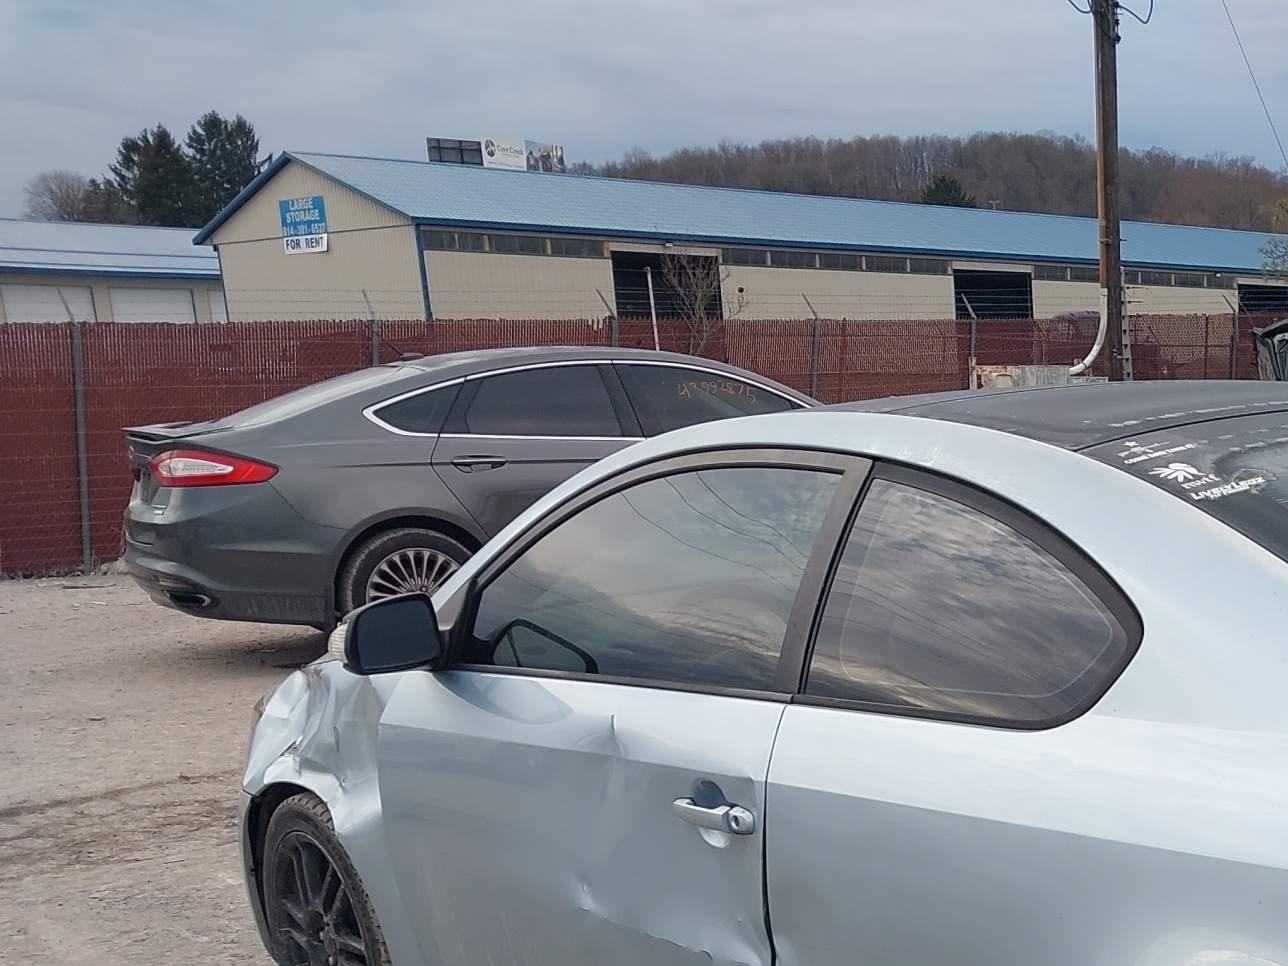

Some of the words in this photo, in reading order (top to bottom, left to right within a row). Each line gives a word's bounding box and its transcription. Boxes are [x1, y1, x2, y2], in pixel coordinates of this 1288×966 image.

[288, 198, 313, 210] LARGE
[286, 209, 320, 223] STORAGE
[285, 238, 301, 250] FOR
[305, 236, 324, 249] RENT
